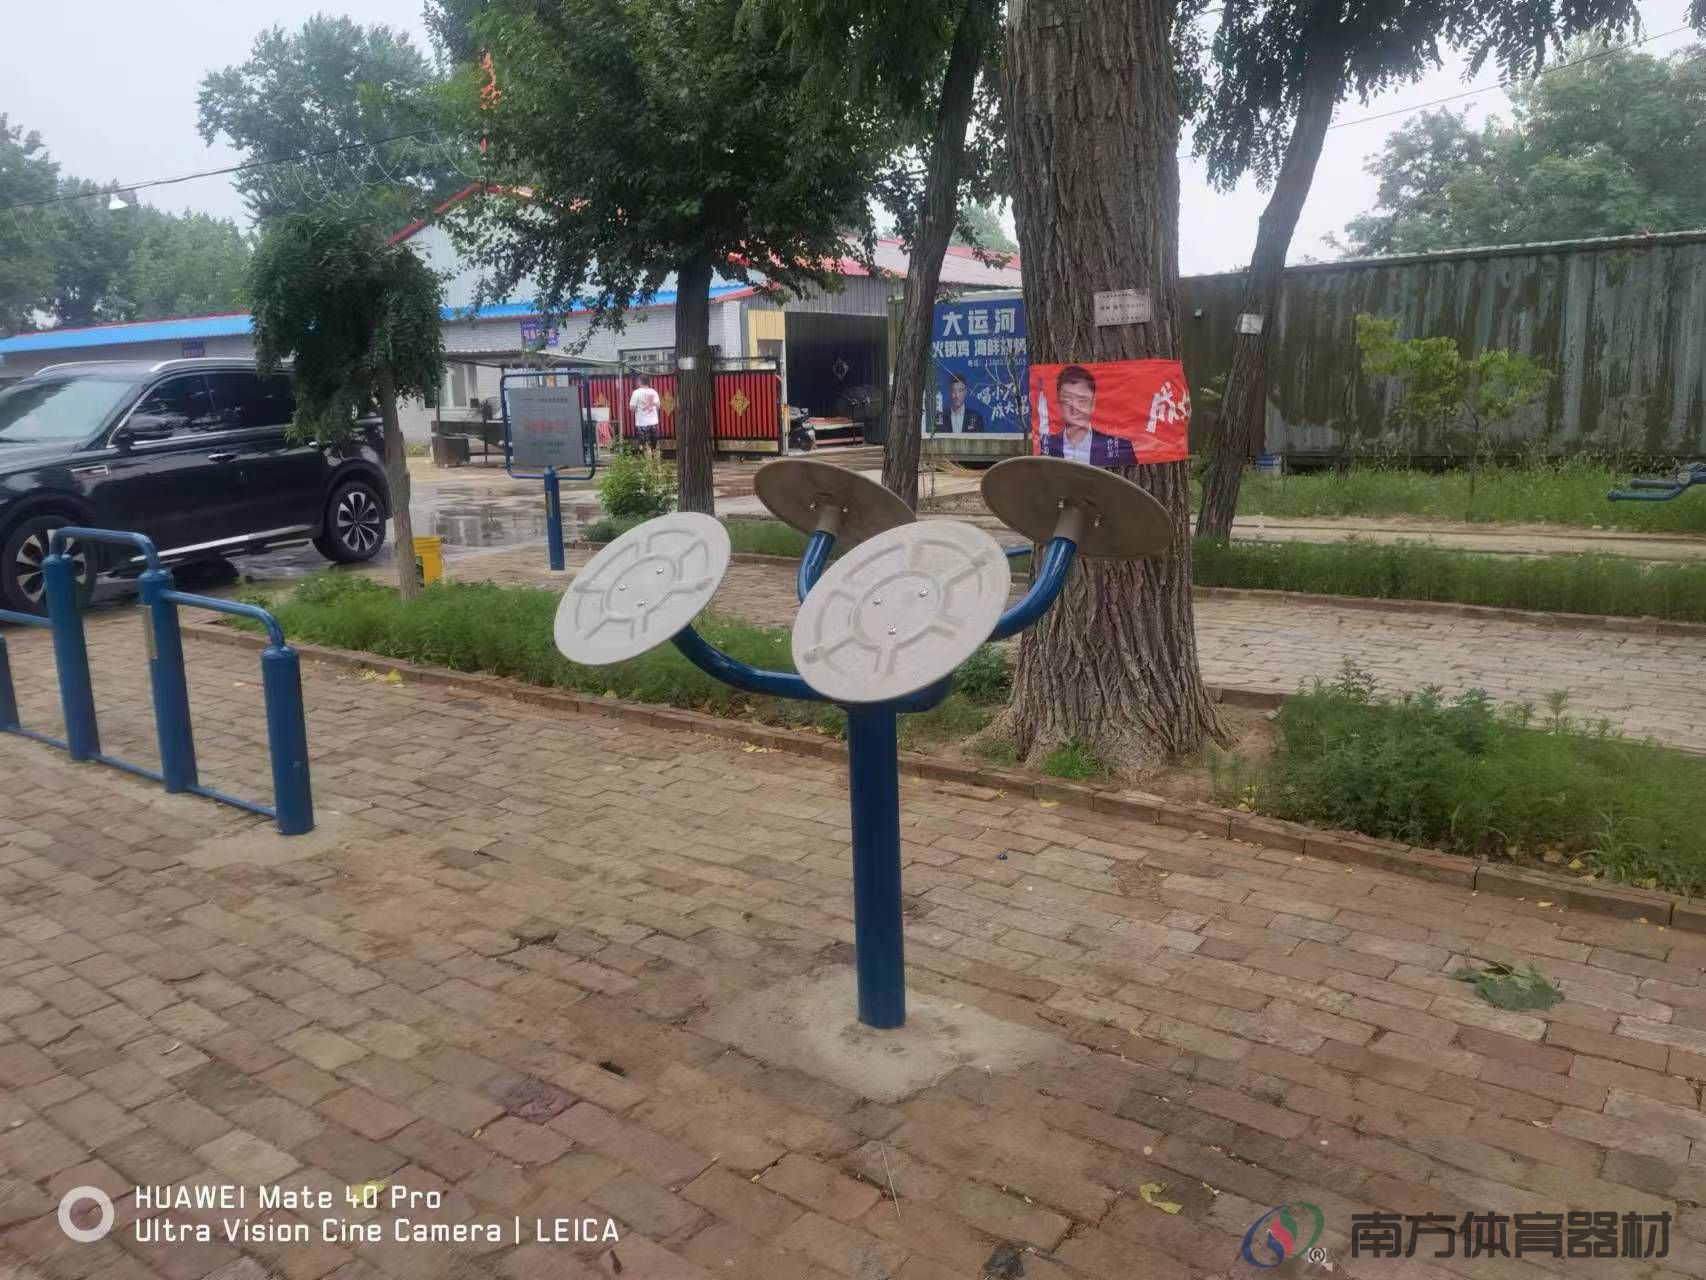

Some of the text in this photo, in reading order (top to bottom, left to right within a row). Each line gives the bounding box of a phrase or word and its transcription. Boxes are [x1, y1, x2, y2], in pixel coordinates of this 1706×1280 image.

[942, 308, 1016, 336] 大运河
[932, 340, 970, 358] 火锅鸡
